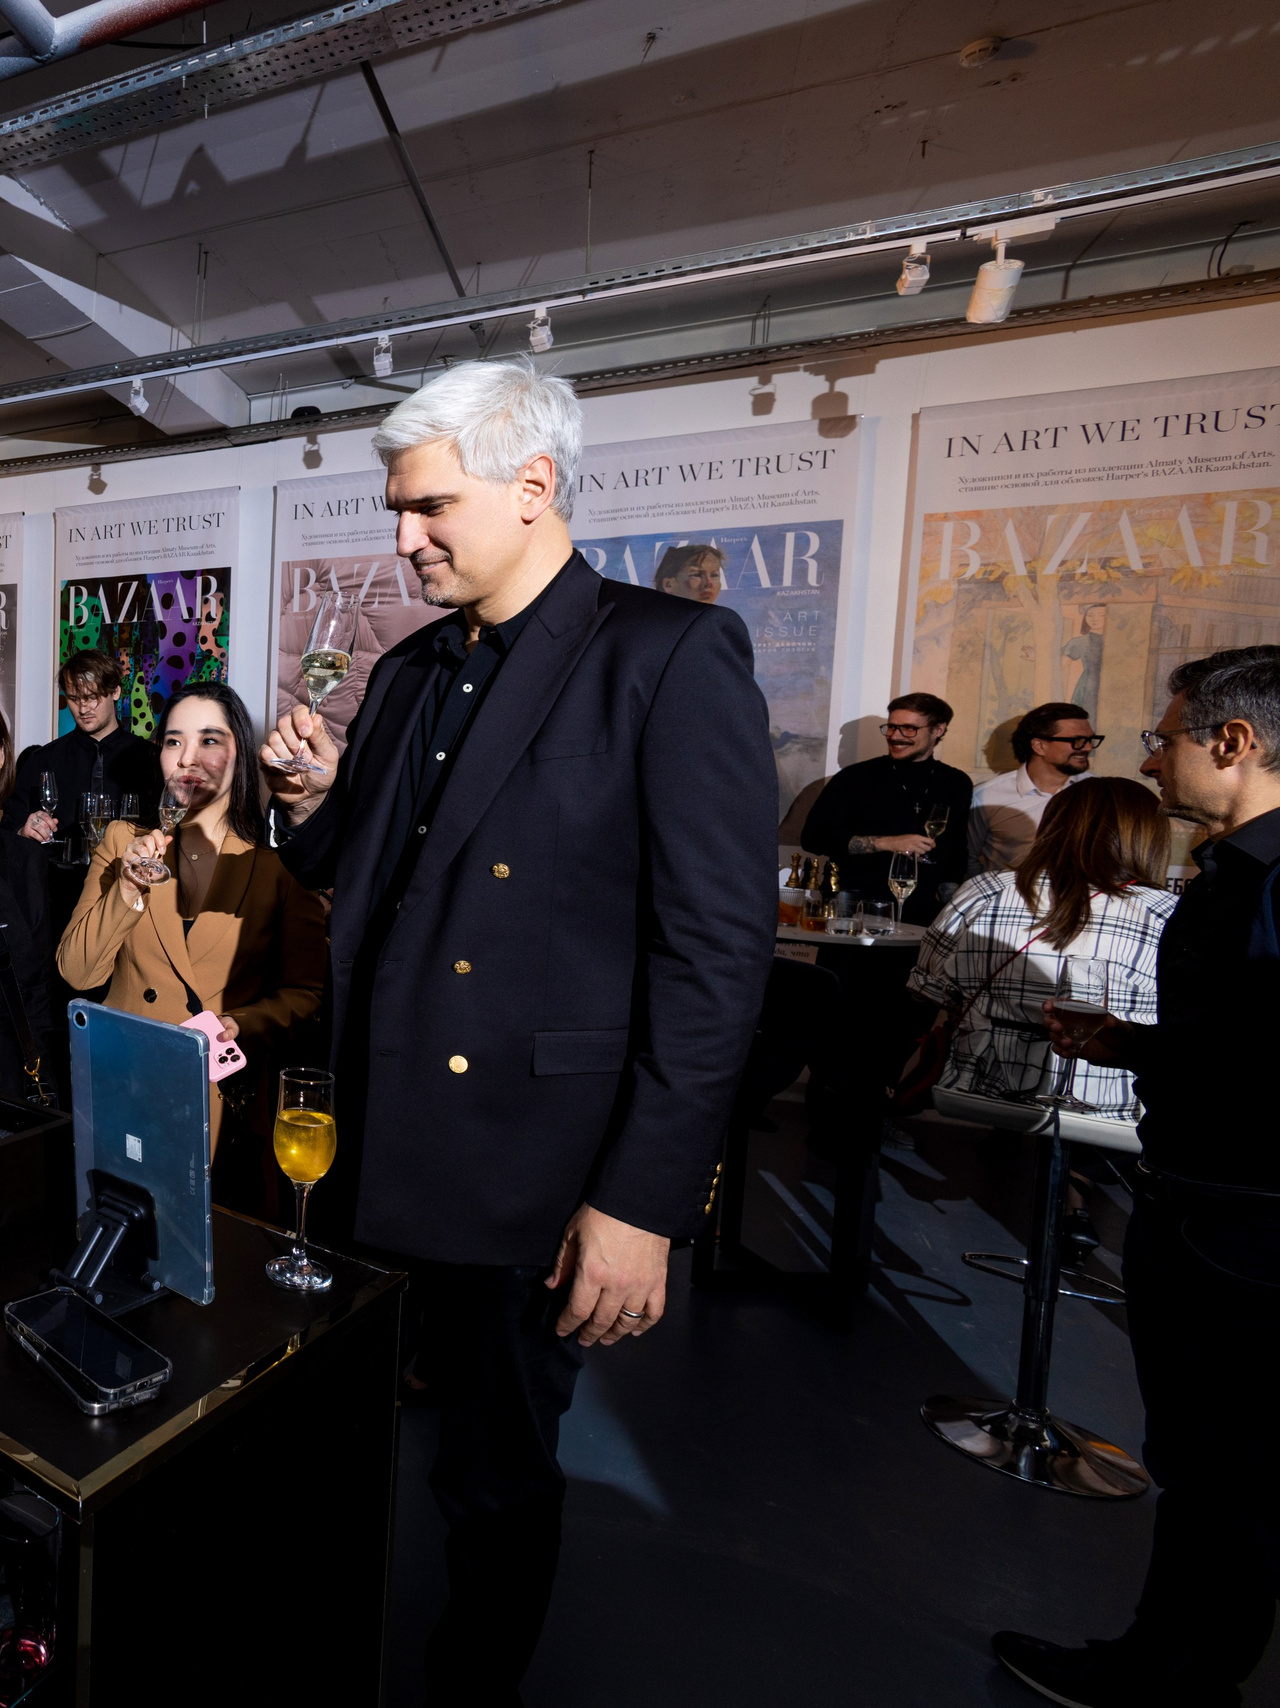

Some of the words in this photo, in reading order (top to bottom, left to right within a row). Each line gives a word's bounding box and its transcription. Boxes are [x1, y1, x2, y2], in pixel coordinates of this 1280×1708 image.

[944, 434, 982, 459] IN
[992, 425, 1068, 454] ART
[1079, 418, 1141, 445] WE
[578, 472, 606, 493] IN
[613, 465, 670, 490] ART
[678, 460, 723, 483] WE
[731, 448, 836, 478] TRUST
[957, 474, 1013, 485] Художники
[1036, 468, 1072, 479] работы
[1088, 463, 1143, 473] коллекции
[1145, 459, 1184, 468] Almaty
[1186, 455, 1232, 464] Museum
[1233, 451, 1246, 460] of
[958, 484, 999, 493] ставшие
[1000, 480, 1040, 489] основой
[1041, 479, 1059, 487] для
[1060, 475, 1104, 484] обложек
[1151, 466, 1203, 477] BAZAAR
[1205, 461, 1272, 473] Kazakhstan.
[293, 503, 314, 520] IN
[321, 497, 364, 518] ART
[371, 495, 388, 512] W
[727, 495, 754, 503] Almaty
[756, 493, 790, 501] Museum
[791, 489, 801, 497] of
[68, 527, 86, 543] IN
[90, 523, 125, 541] ART
[130, 519, 159, 537] WE
[162, 512, 225, 534] TRUST
[935, 500, 1277, 580] BAZAAR
[67, 575, 218, 627] BAZAAR
[291, 560, 412, 613] BAZA
[776, 589, 820, 597] KAZAKHSTAN
[756, 625, 818, 638] ISSUE
[782, 610, 821, 622] ART
